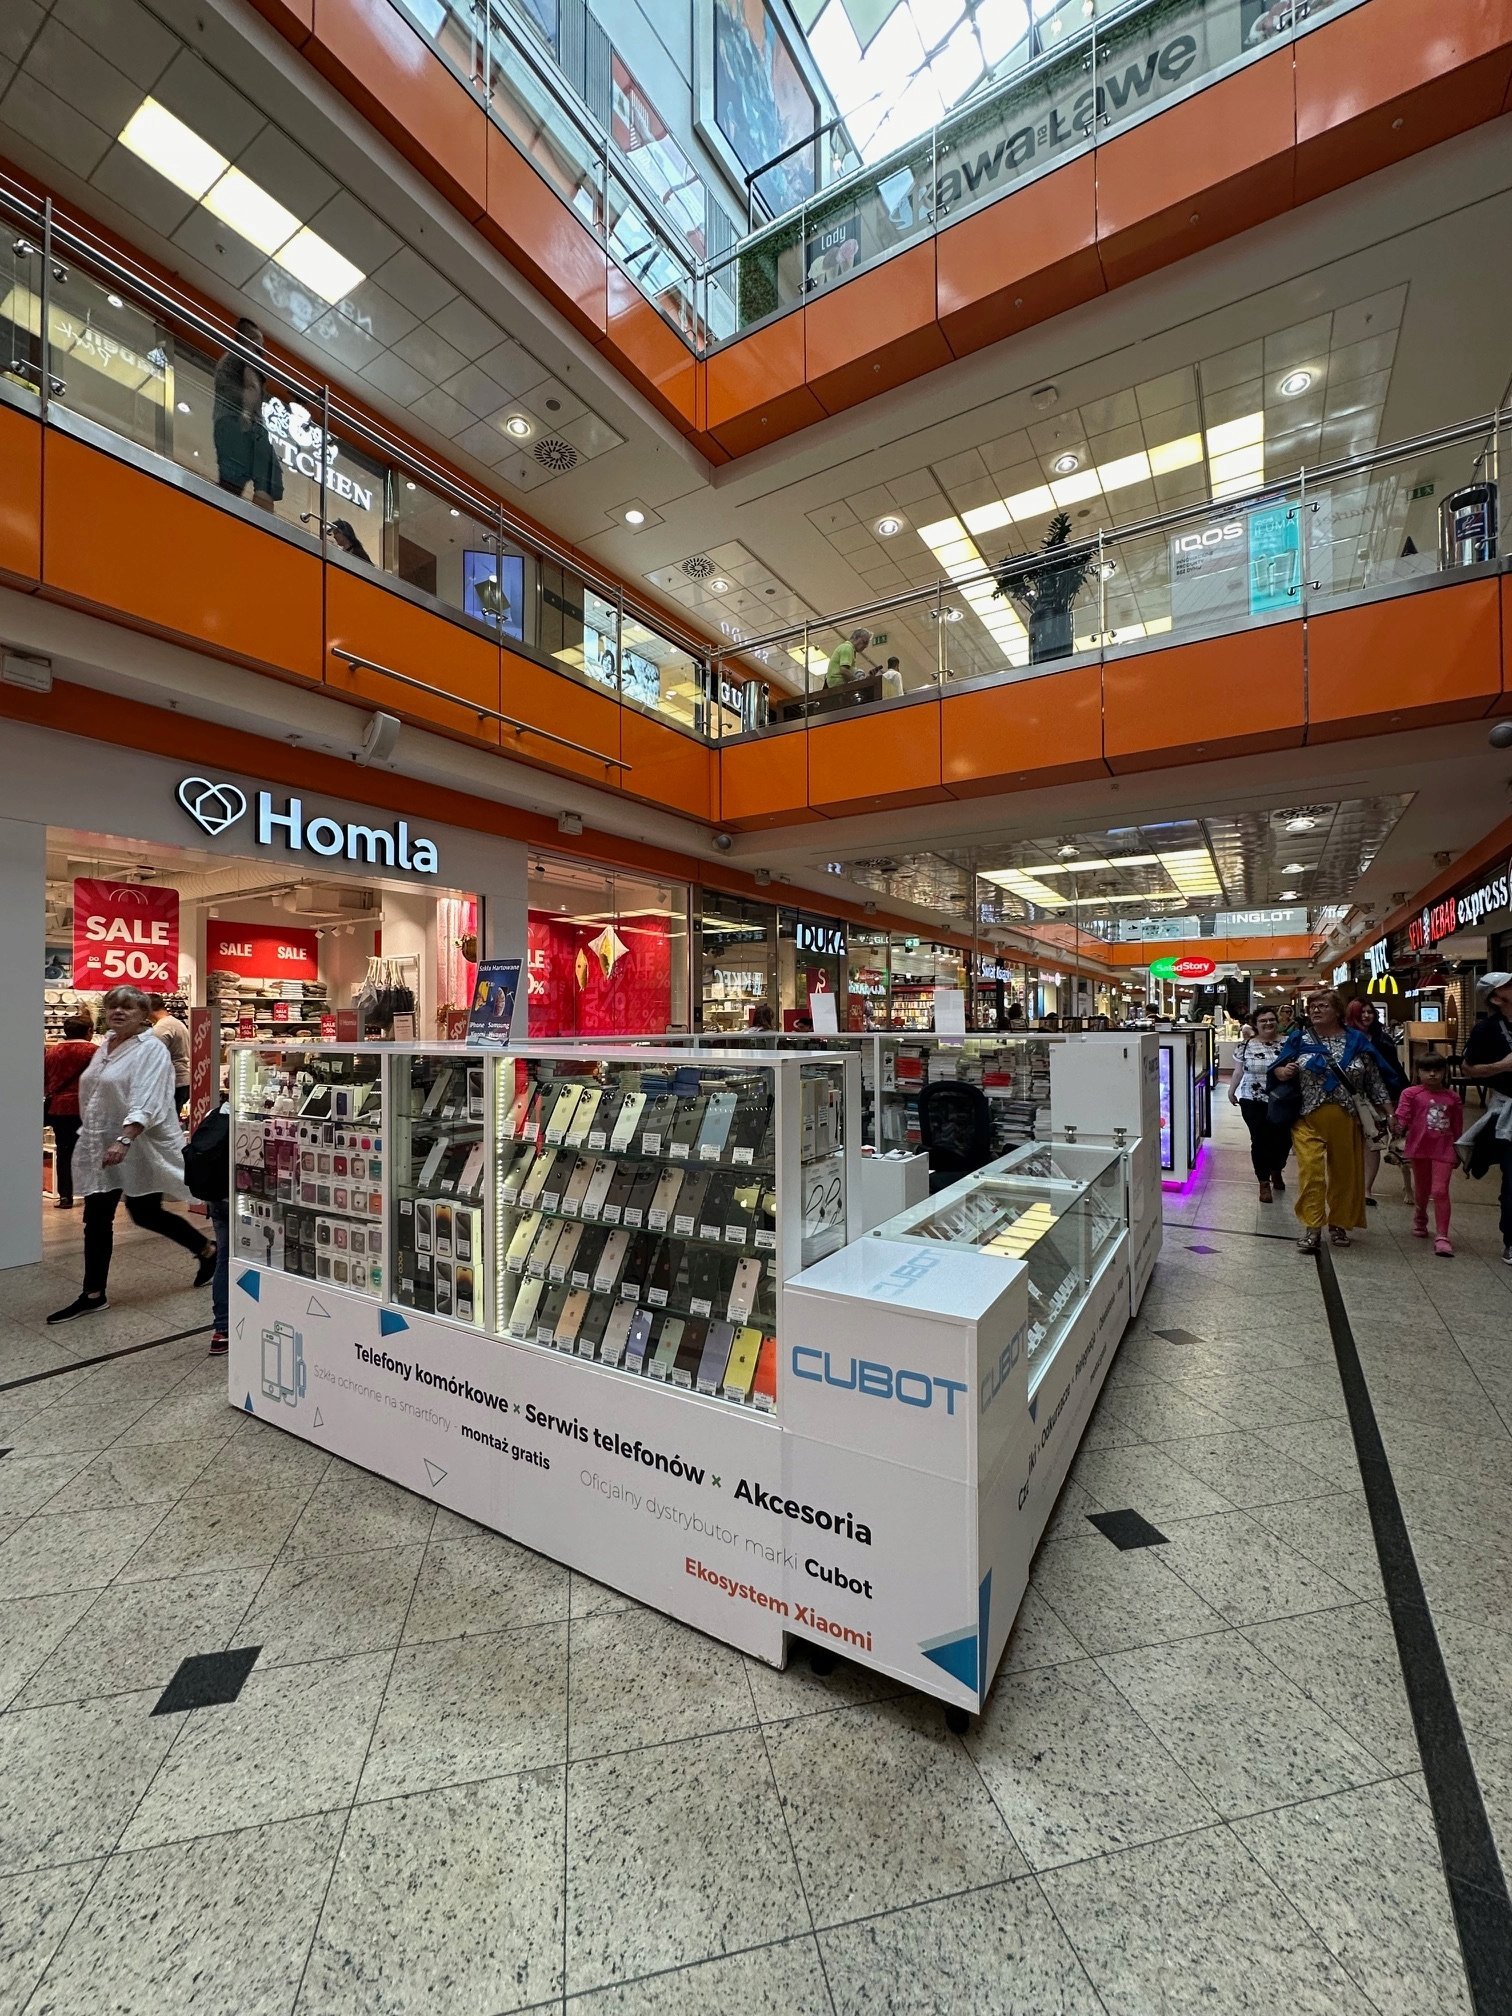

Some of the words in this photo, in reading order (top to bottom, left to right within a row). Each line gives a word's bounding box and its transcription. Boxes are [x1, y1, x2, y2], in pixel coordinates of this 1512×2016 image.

[1048, 32, 1197, 148] Ławę
[268, 432, 373, 511] TCHEN
[1175, 522, 1244, 554] IQOS
[257, 790, 438, 874] Homla
[85, 915, 170, 946] SALE
[1231, 910, 1295, 924] INGLOT
[1430, 897, 1456, 942] KEBAB
[1457, 875, 1508, 926] express
[87, 949, 169, 981] -50%
[220, 942, 252, 957] SALE
[277, 946, 307, 960] SALE
[797, 923, 847, 956] DUKA
[194, 1017, 211, 1053] -50%
[488, 1021, 510, 1029] Samsung
[194, 1054, 211, 1090] -50%
[792, 1345, 968, 1416] CUBOT
[981, 1319, 1028, 1415] CUBOT
[313, 1363, 336, 1384] Szkła
[337, 1373, 382, 1402] ochronne
[384, 1393, 397, 1409] na
[399, 1397, 451, 1432] smartfony
[461, 1424, 509, 1454] montaż
[511, 1442, 550, 1470] gratis
[354, 1342, 412, 1380] Telefony
[415, 1363, 509, 1413] komórkowe
[525, 1403, 589, 1443] Serwis
[593, 1428, 706, 1485] telefonów
[733, 1478, 873, 1546] Akcesoria
[580, 1469, 642, 1511] Oficjalny
[645, 1496, 739, 1548] dystrybutor
[745, 1537, 798, 1571] marki
[804, 1558, 873, 1600] Cubot
[685, 1556, 789, 1617] Ekosystem
[793, 1602, 873, 1652] Xiaomi
